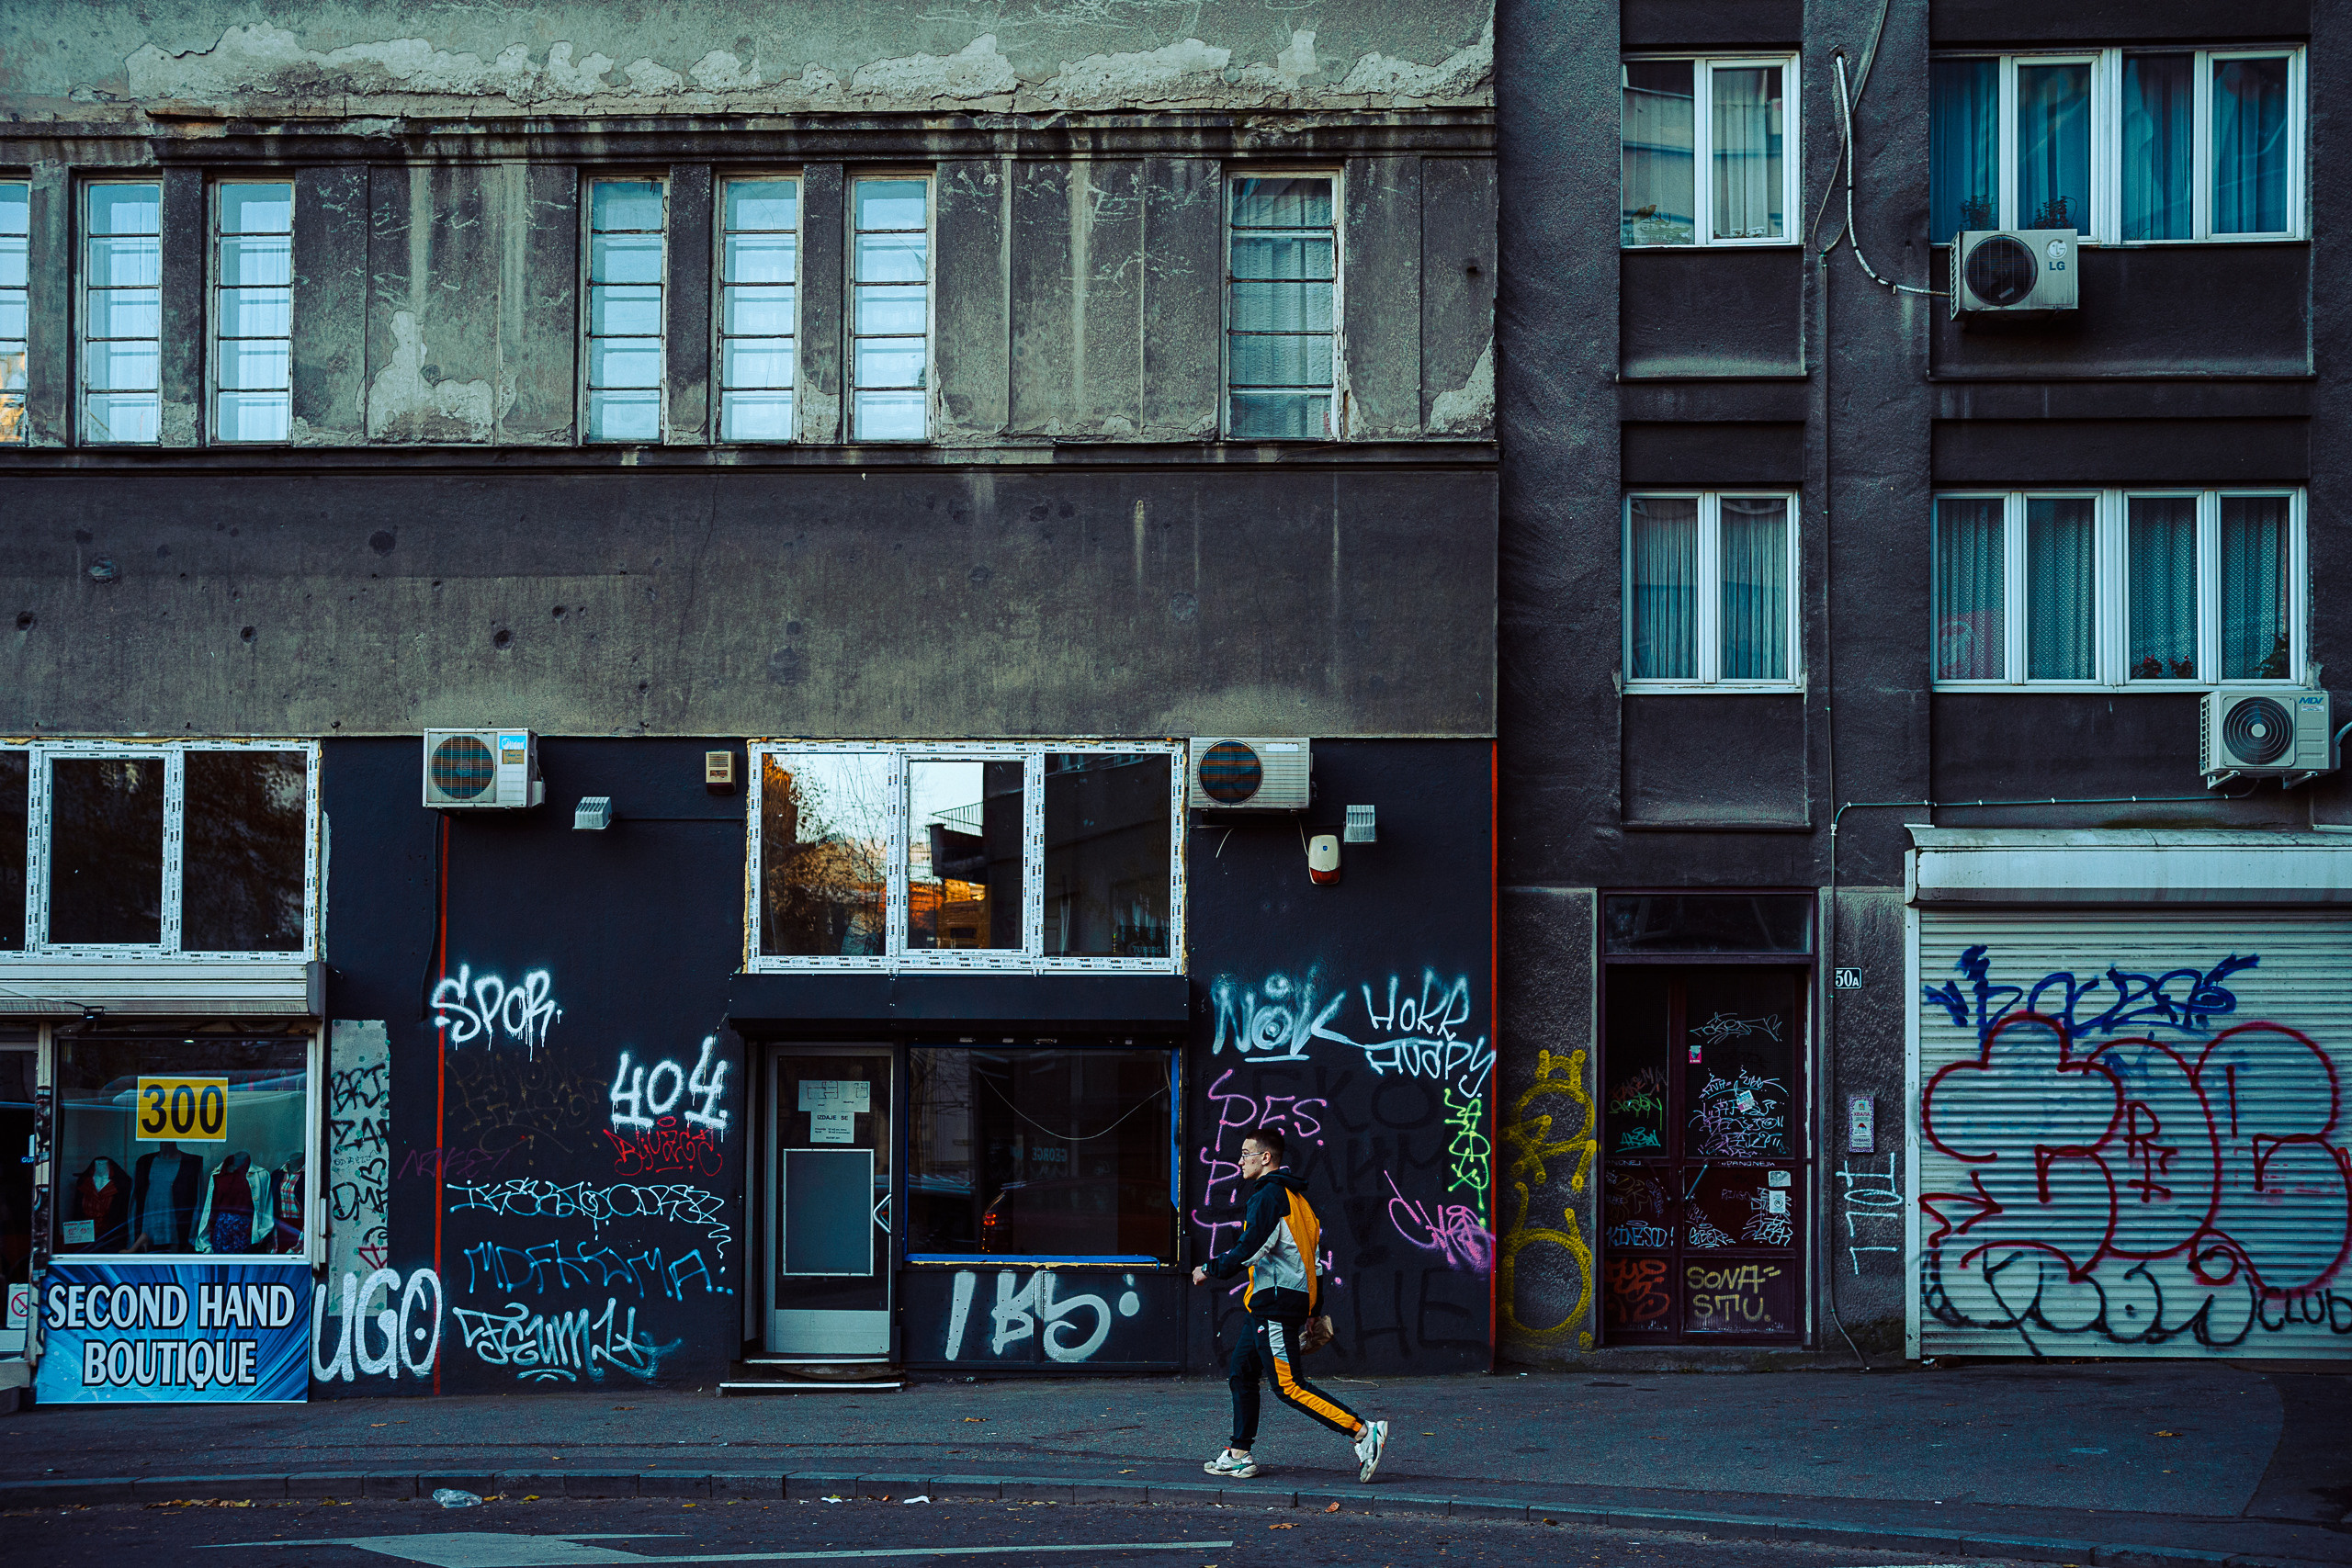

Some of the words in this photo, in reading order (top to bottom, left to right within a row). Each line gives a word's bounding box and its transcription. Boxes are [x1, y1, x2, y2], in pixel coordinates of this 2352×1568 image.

[2049, 261, 2065, 271] LG
[2298, 696, 2324, 705] MDV
[1132, 945, 1162, 954] TUBORG
[1835, 969, 1860, 987] 50A
[141, 1084, 224, 1134] 300
[46, 1282, 189, 1330] SECOND
[197, 1282, 297, 1330] HAND
[313, 1268, 442, 1381] UGO
[82, 1338, 259, 1392] BOUTIQUE
